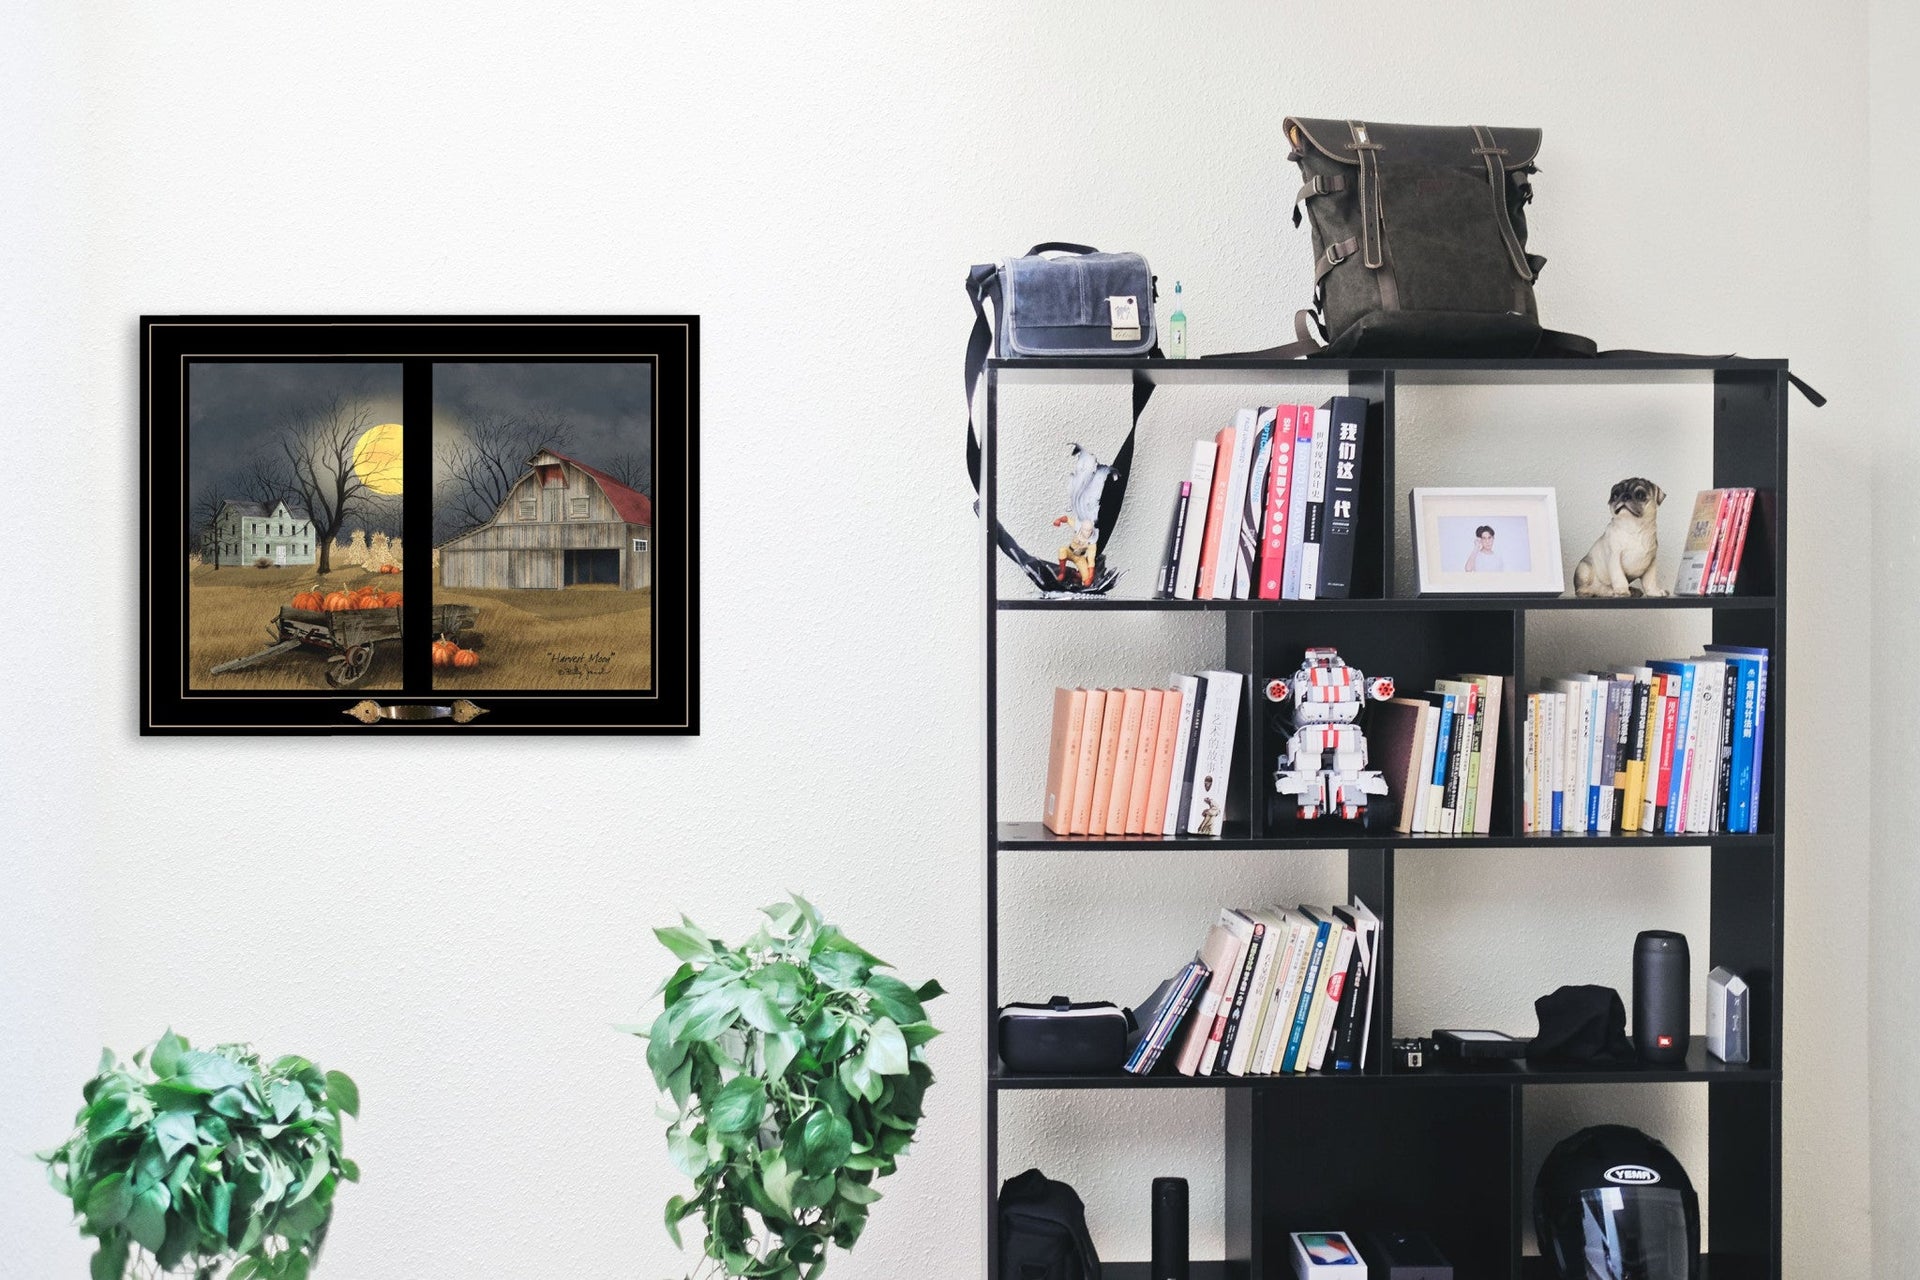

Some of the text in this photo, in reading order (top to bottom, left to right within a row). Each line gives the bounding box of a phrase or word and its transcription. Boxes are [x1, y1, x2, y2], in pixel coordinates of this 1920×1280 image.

[1252, 421, 1271, 503] OPTICAL ILLUSIONS
[1333, 422, 1358, 518] 我们这一代
